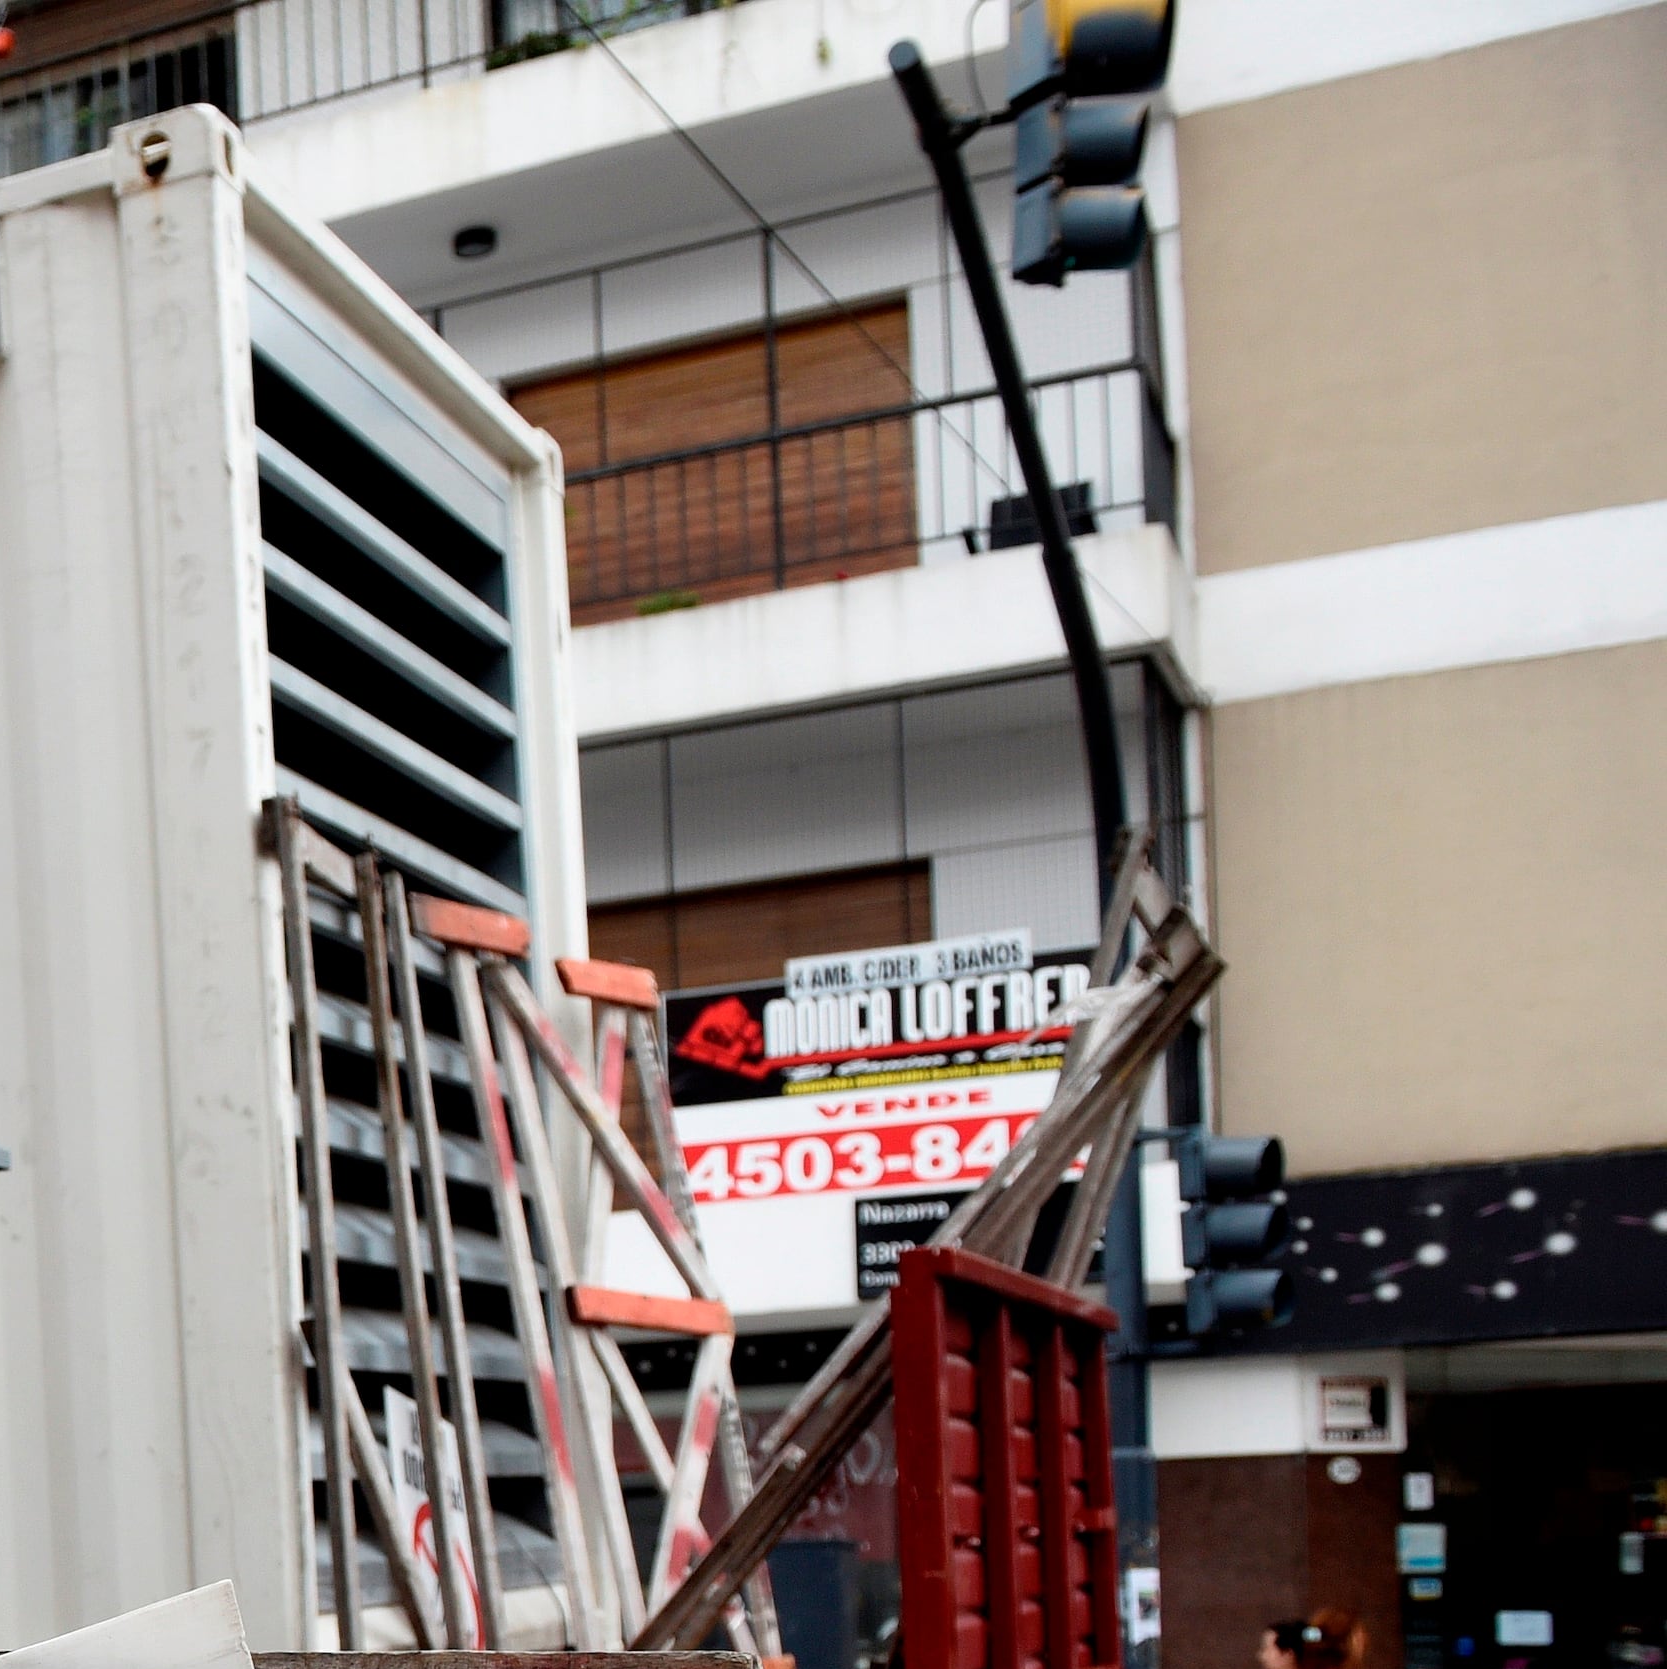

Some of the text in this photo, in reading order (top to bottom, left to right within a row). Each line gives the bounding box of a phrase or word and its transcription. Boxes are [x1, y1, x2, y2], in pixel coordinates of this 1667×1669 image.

[953, 936, 1024, 970] BAÑOS
[763, 986, 894, 1059] MONICA
[817, 1088, 992, 1118] VENDE
